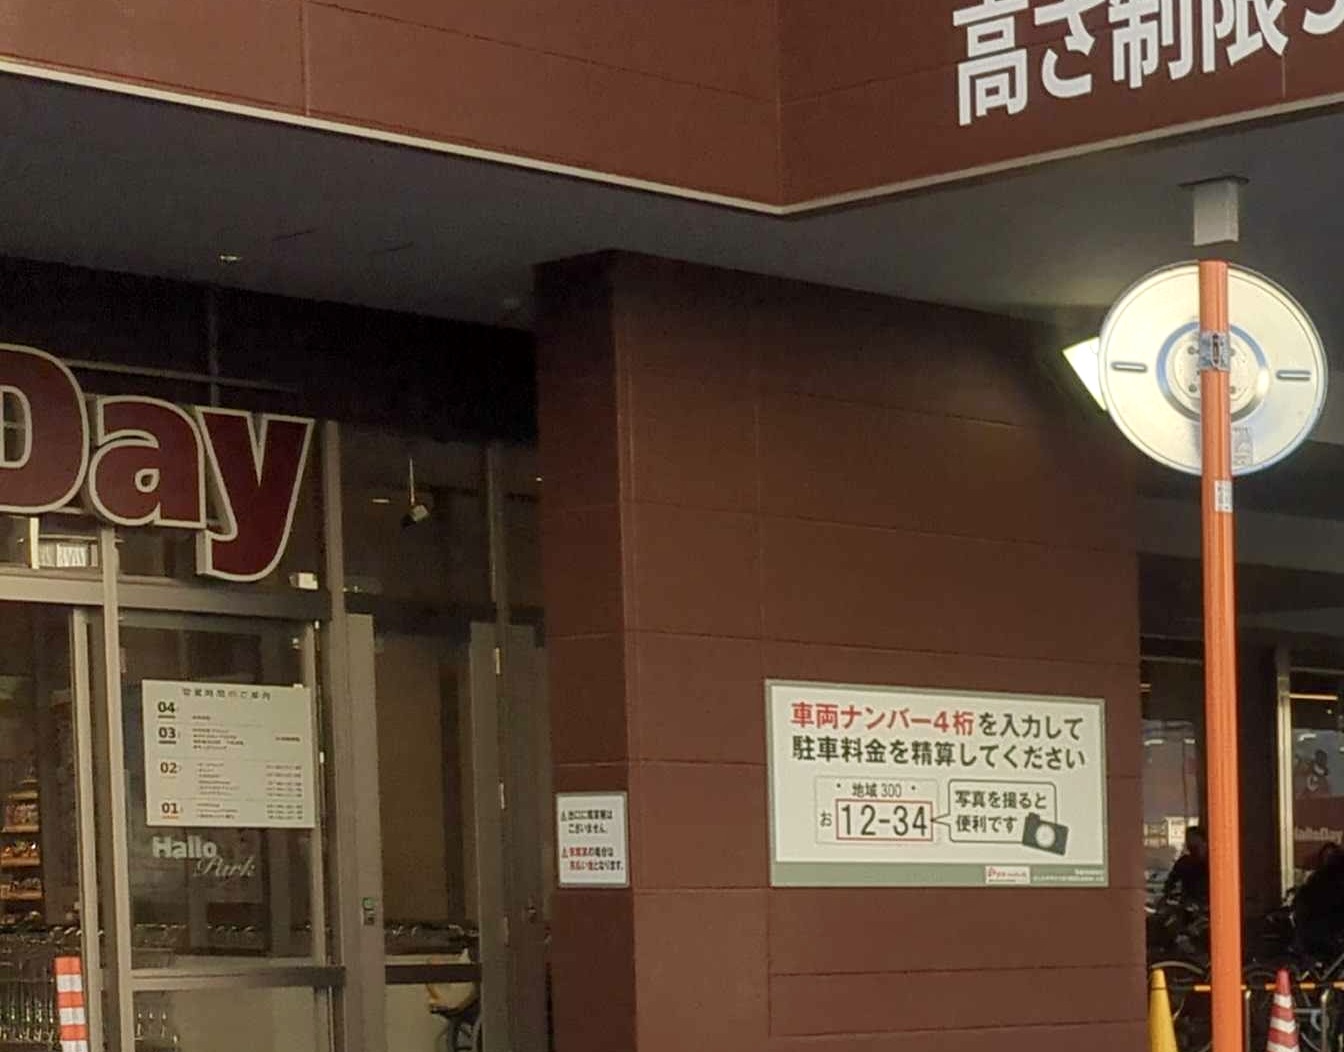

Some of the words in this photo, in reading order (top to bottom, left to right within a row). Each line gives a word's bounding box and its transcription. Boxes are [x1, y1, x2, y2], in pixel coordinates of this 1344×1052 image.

[790, 701, 1086, 742] 車両ナンバー4桁を入力して
[791, 735, 1087, 771] 駐車料金を精算してください
[851, 782, 878, 798] 地域
[881, 783, 903, 798] 300
[954, 789, 1048, 810] 写真を撮ると
[820, 811, 833, 828] お
[840, 804, 929, 837] 12-34
[955, 814, 1018, 834] 便利です
[152, 834, 218, 859] Hallo
